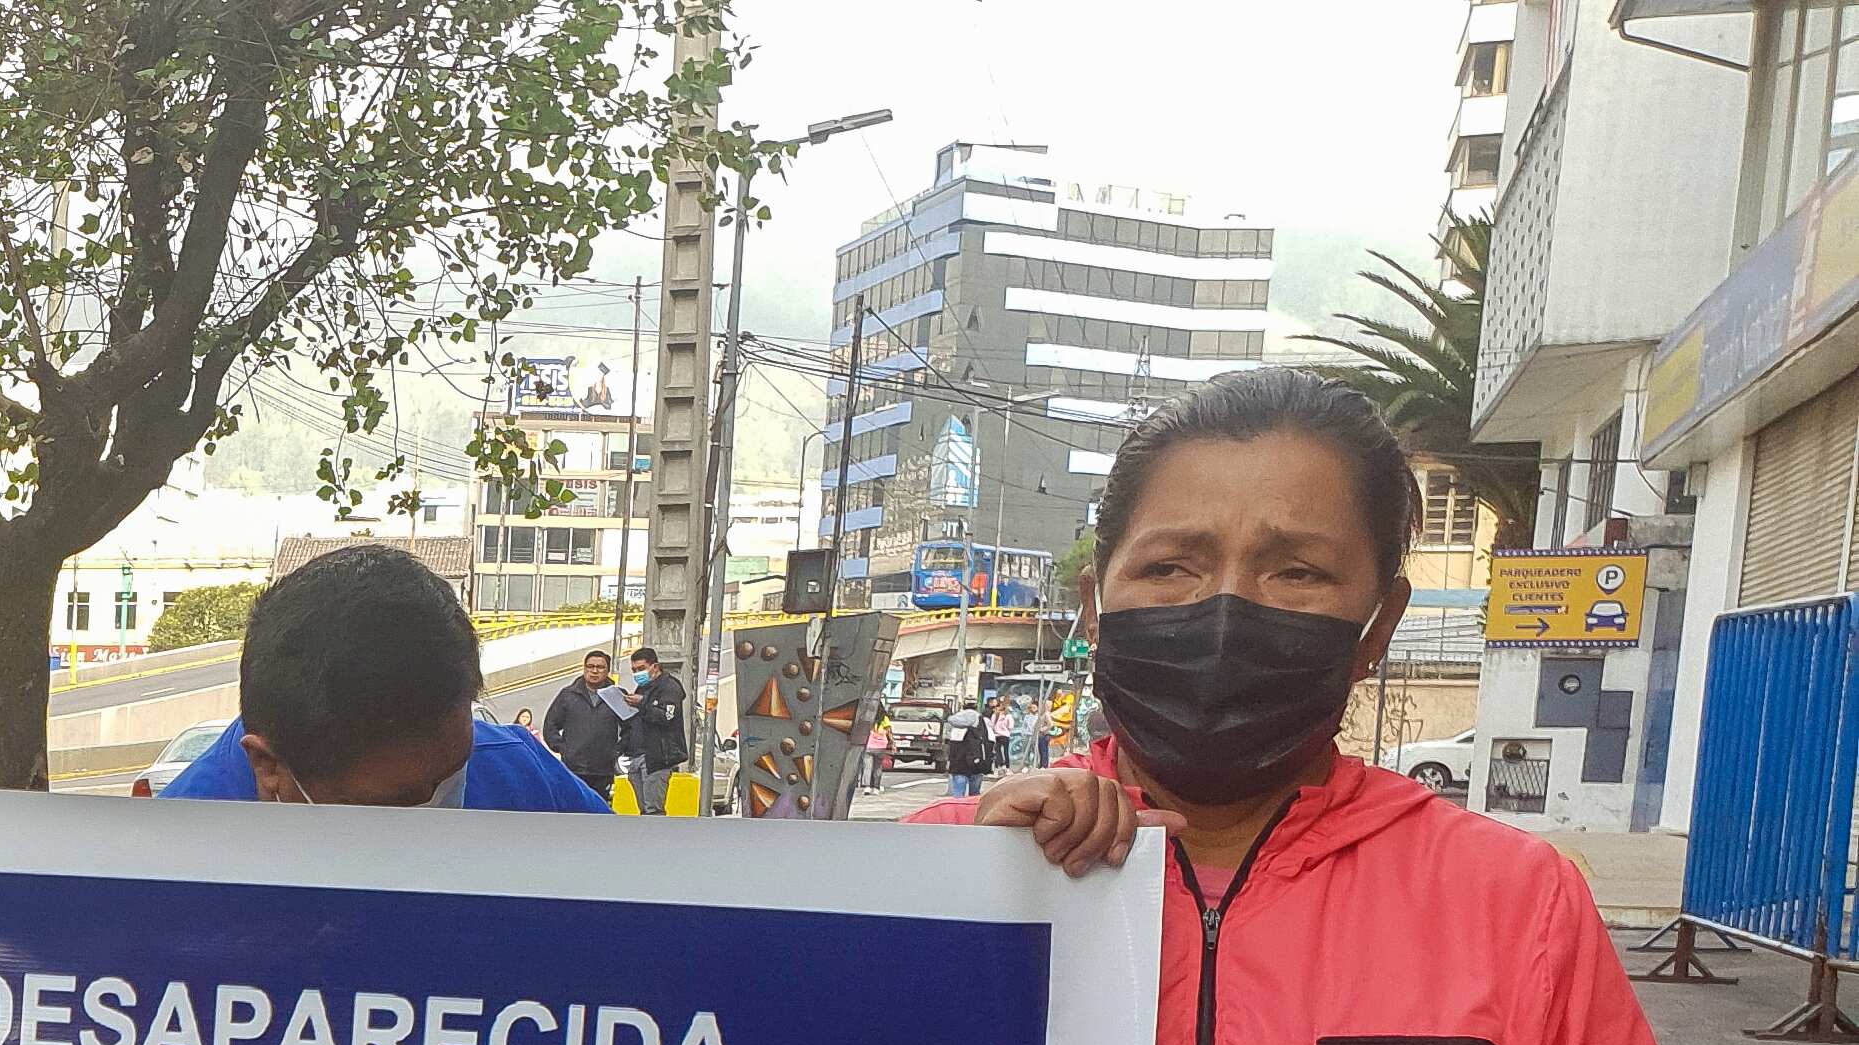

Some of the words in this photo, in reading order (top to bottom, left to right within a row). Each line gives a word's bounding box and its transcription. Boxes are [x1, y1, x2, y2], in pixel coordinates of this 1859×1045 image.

[1500, 568, 1582, 580] PARQUEADERO
[1508, 580, 1571, 590] EXCLUSIVO
[1512, 592, 1564, 602] CLIENTES
